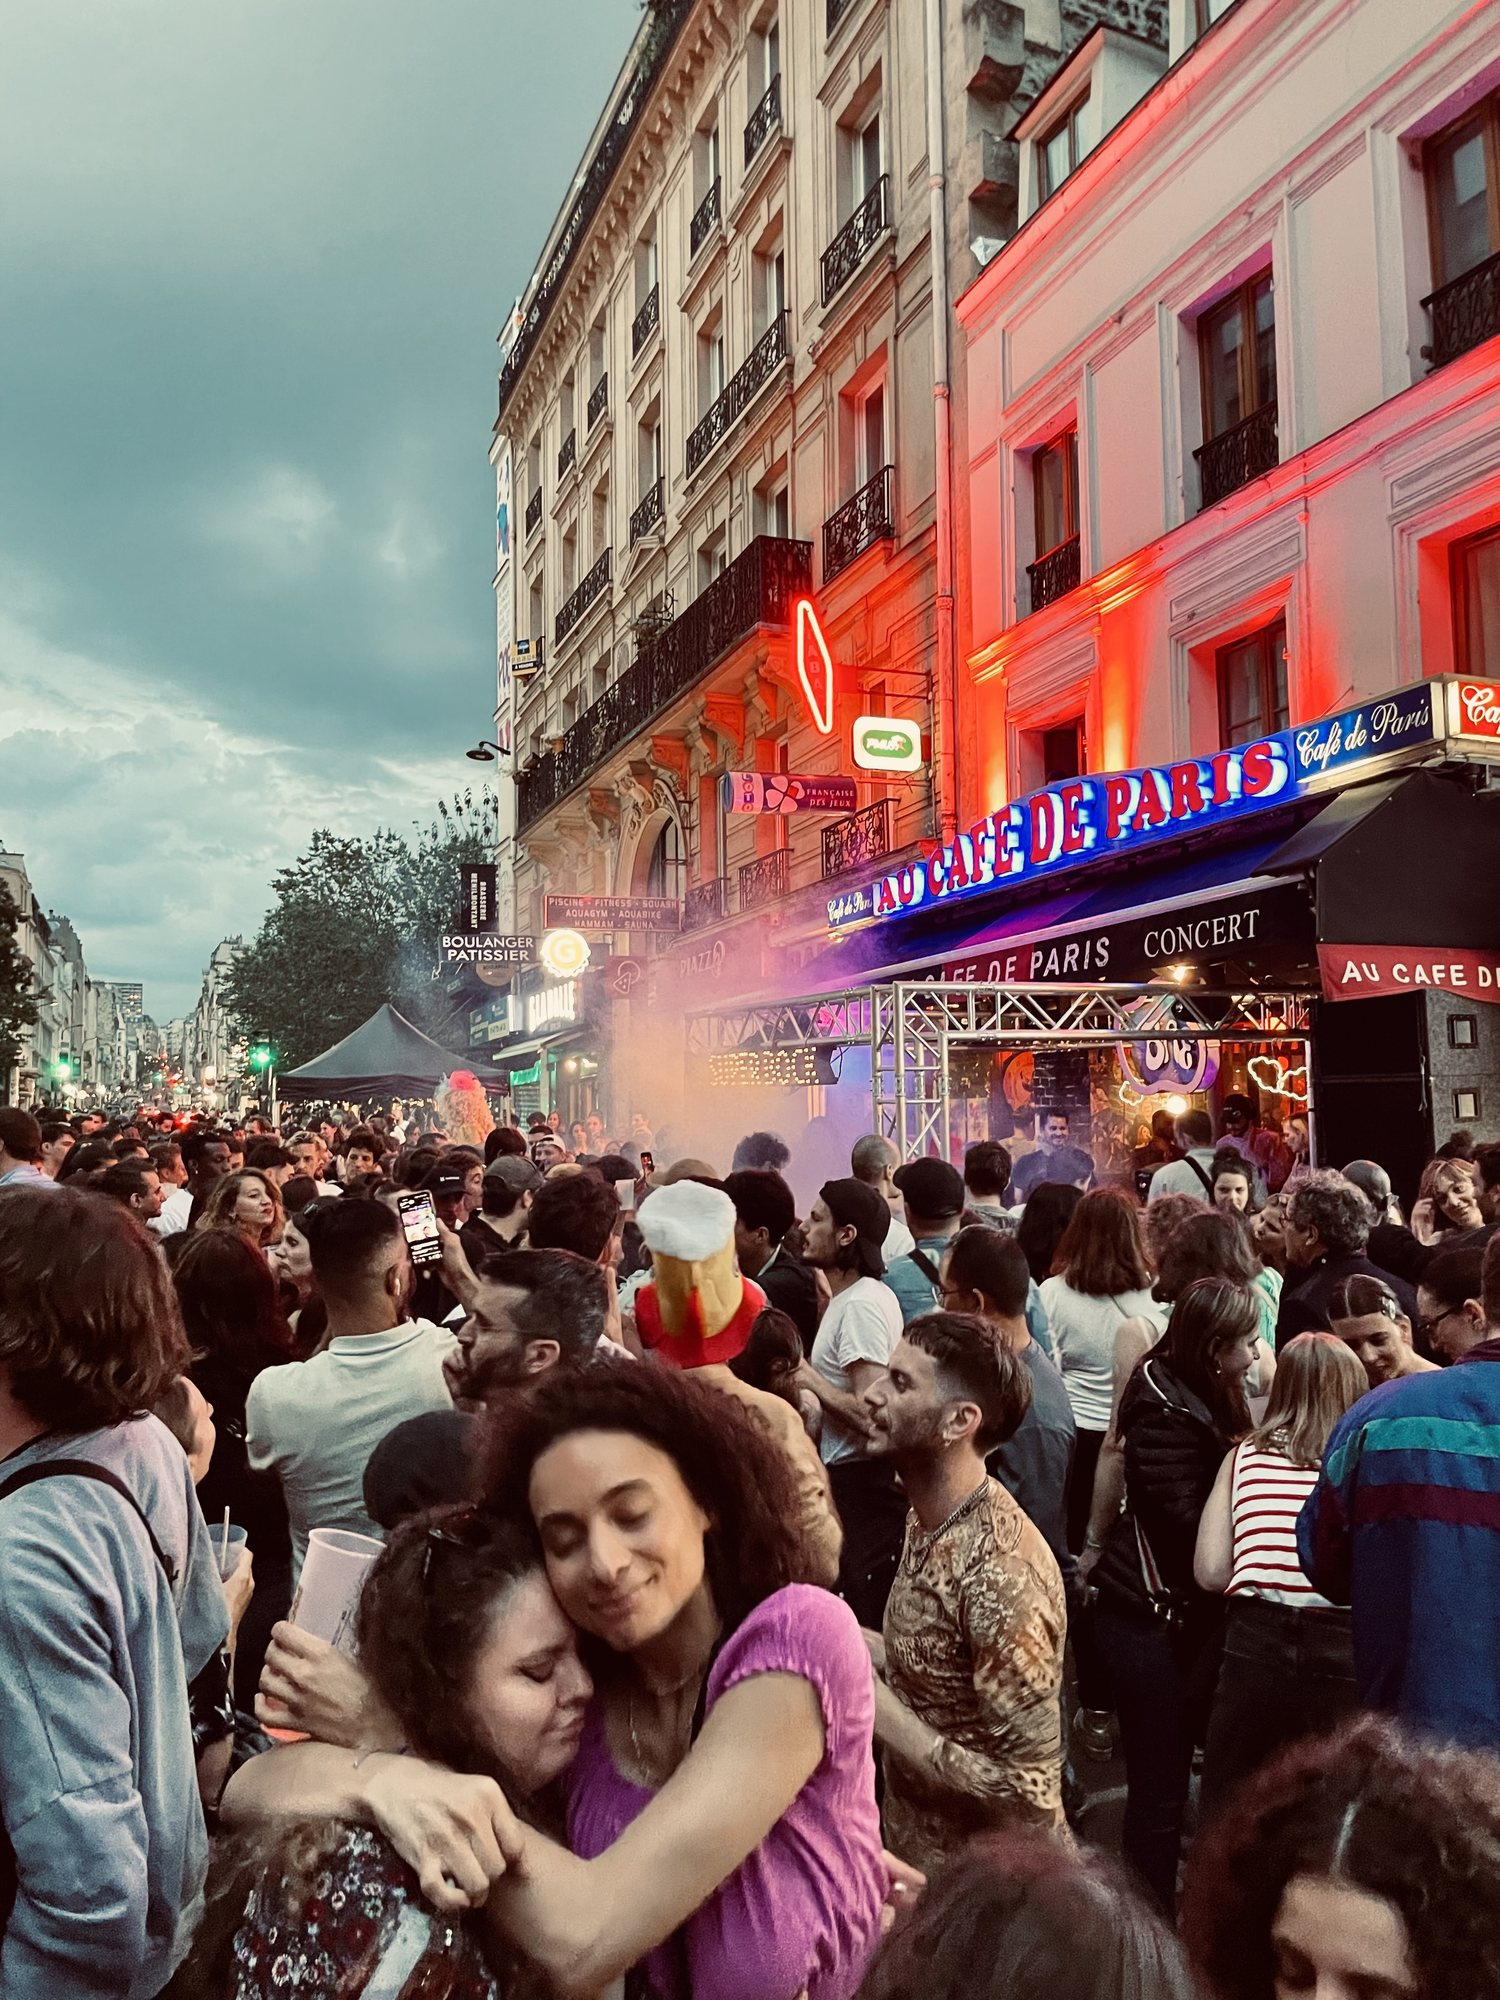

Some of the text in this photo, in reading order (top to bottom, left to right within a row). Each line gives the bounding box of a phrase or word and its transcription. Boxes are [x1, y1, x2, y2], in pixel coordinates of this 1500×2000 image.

[1461, 685, 1500, 735] Ca
[1296, 699, 1429, 769] Café de Paris
[806, 787, 854, 799] FRANÇAISE
[810, 798, 851, 807] DES JEUX
[878, 741, 1288, 914] AU CAFE DE PARIS
[549, 898, 677, 909] PISCINE FITNESS SQUASH
[565, 909, 662, 919] AQUAGYM AQUABIKE
[574, 920, 654, 929] HAMMAM SAUNA
[442, 935, 534, 948] BOULANGER
[987, 955, 1017, 983] DE
[1029, 936, 1110, 979] PARIS
[1144, 909, 1260, 958] CONCERT
[447, 949, 530, 961] PATISSIER
[1341, 960, 1380, 984] AU
[1392, 963, 1467, 986] CAFE
